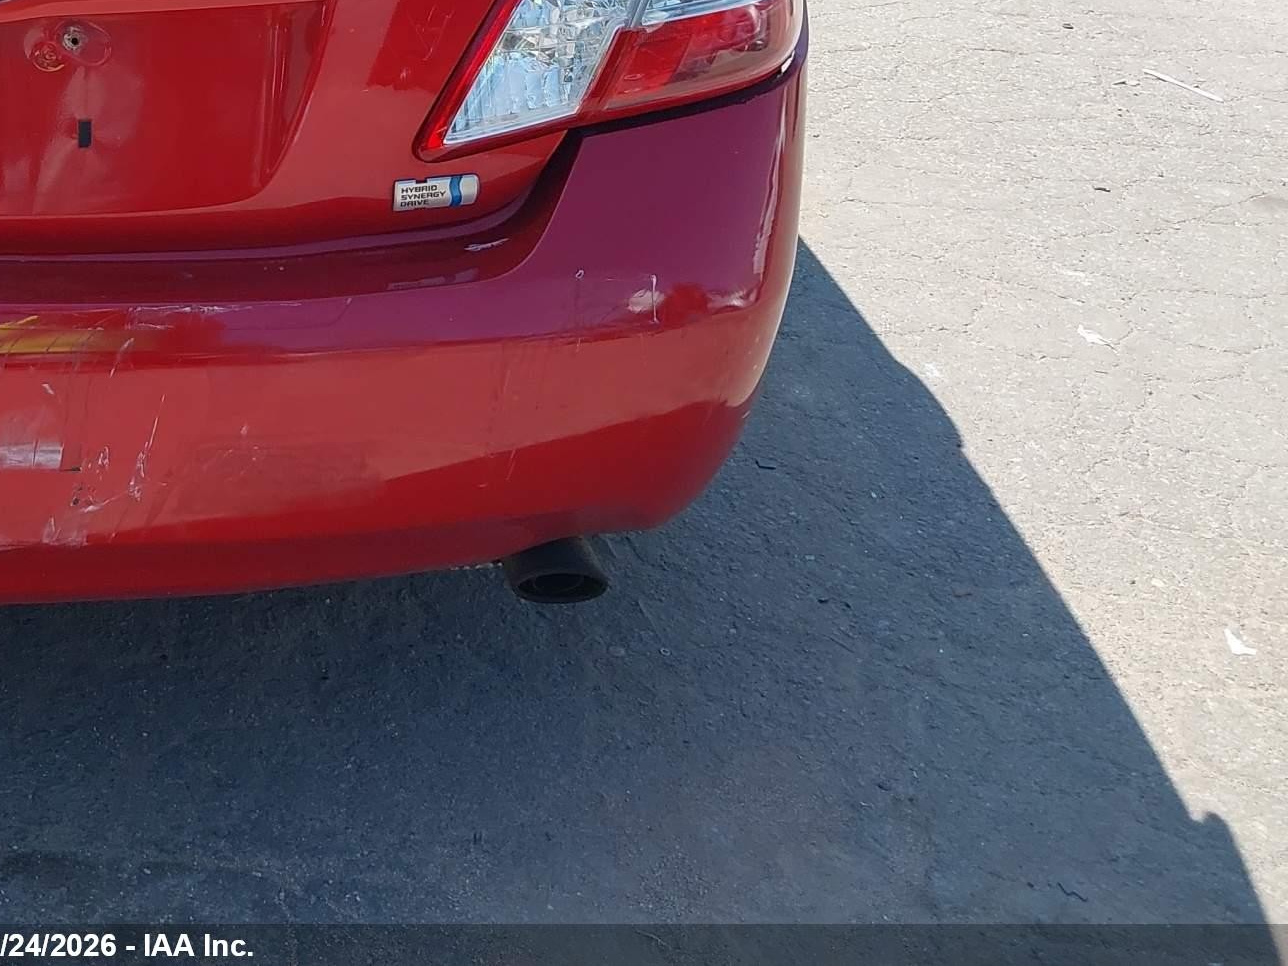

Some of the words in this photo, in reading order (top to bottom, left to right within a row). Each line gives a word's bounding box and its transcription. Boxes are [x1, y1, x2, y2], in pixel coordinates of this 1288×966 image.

[401, 184, 438, 194] HYBRID
[400, 191, 447, 201] SYNERGY
[400, 198, 430, 208] DRIVE
